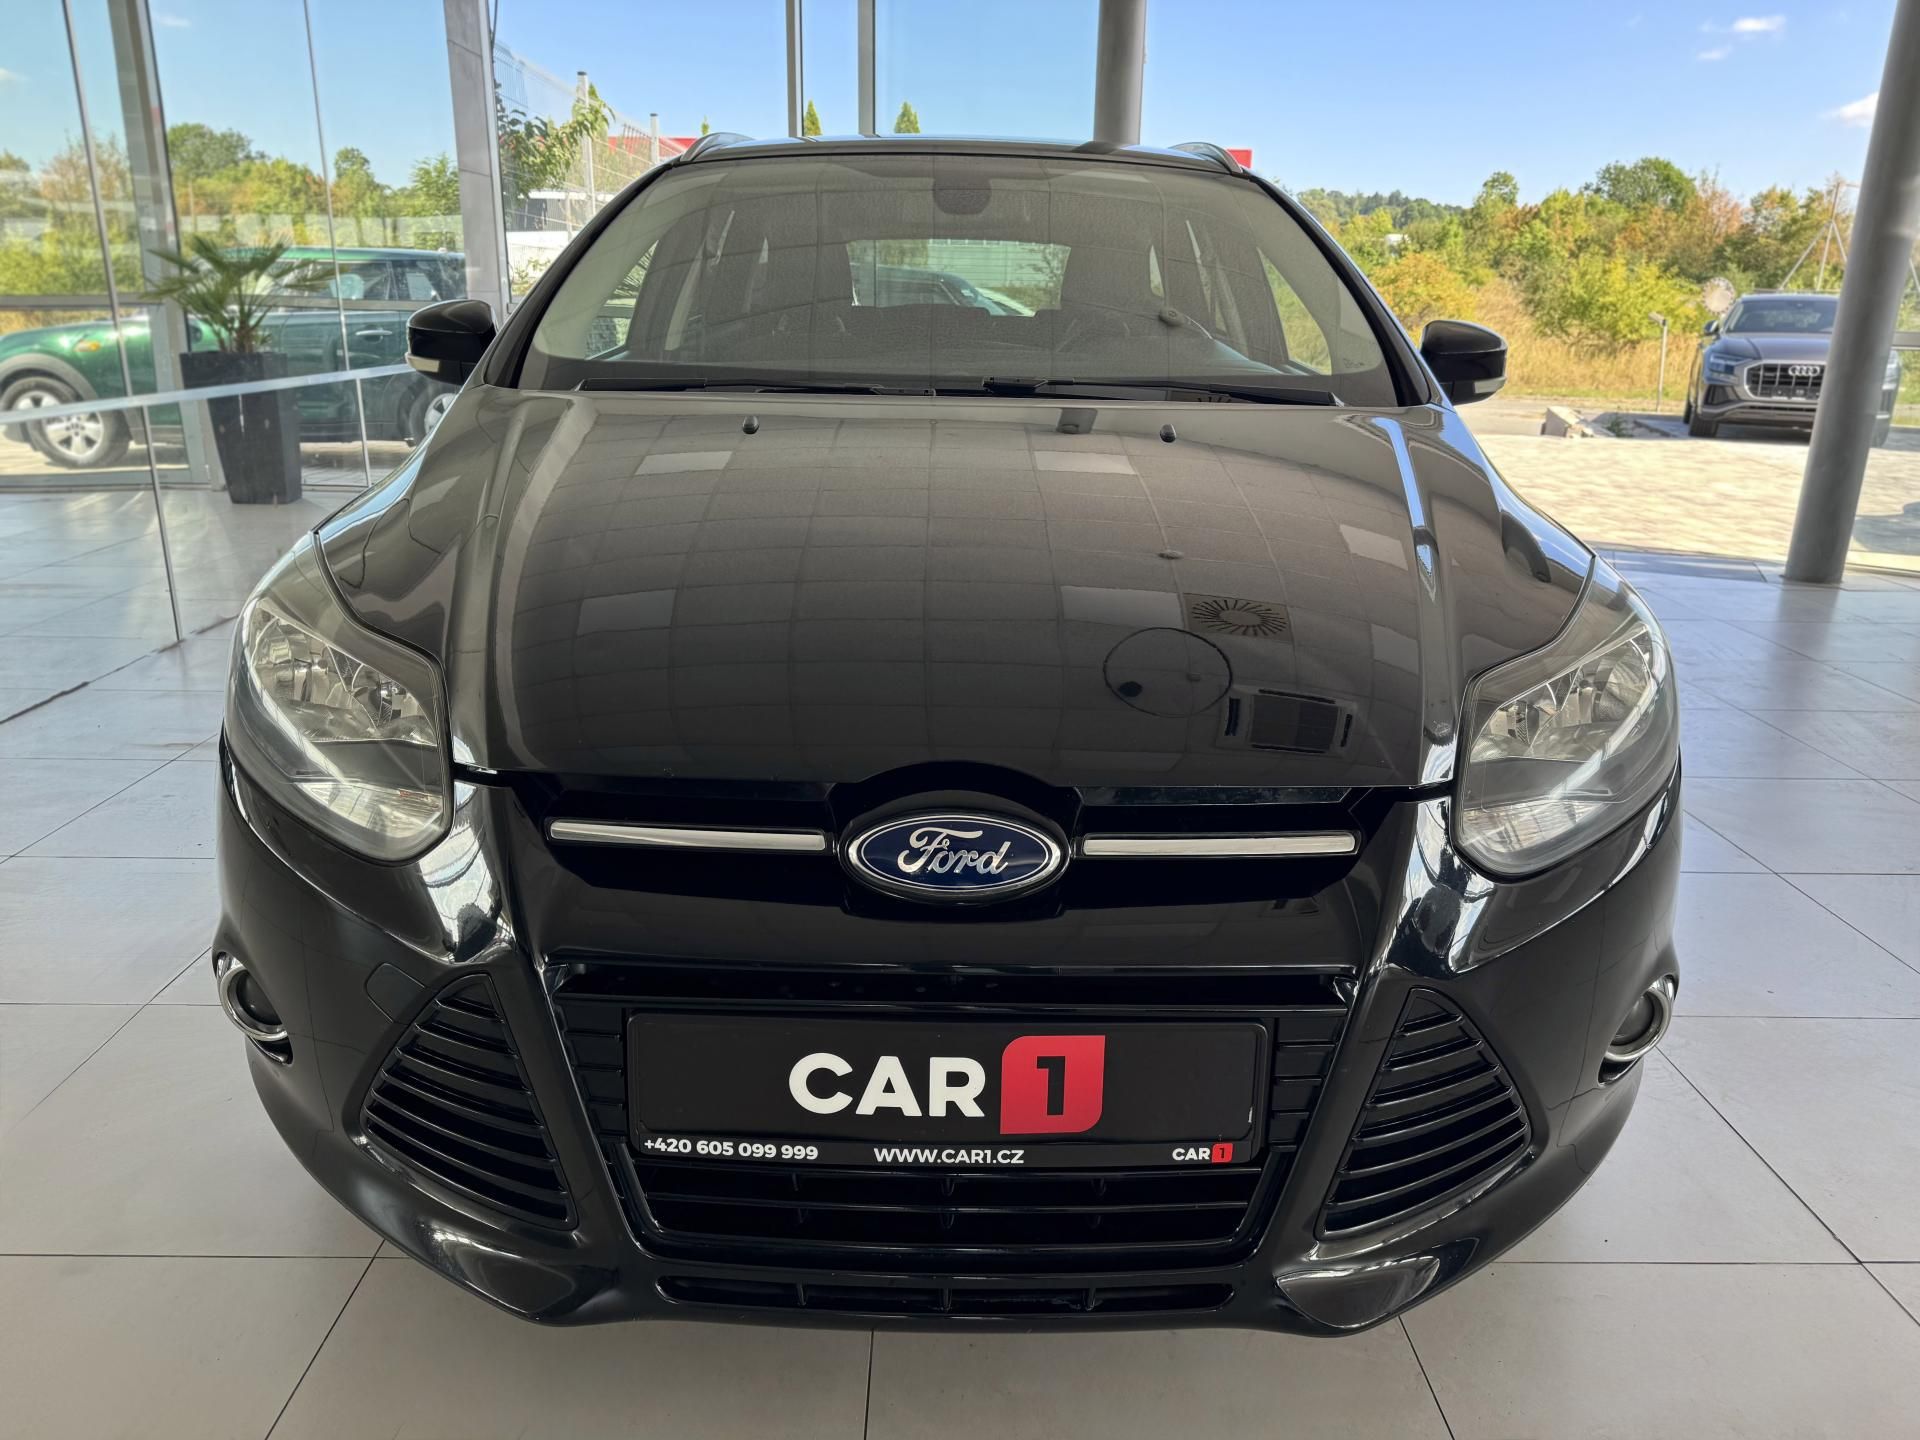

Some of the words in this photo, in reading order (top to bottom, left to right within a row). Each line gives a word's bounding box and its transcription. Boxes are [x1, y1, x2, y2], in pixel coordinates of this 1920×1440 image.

[897, 827, 1009, 875] Ford
[644, 1138, 692, 1153] +420
[696, 1140, 734, 1156] 605
[738, 1143, 777, 1158] 099
[781, 1145, 819, 1160] 999
[873, 1148, 1025, 1164] WWW.CAR1.CZ
